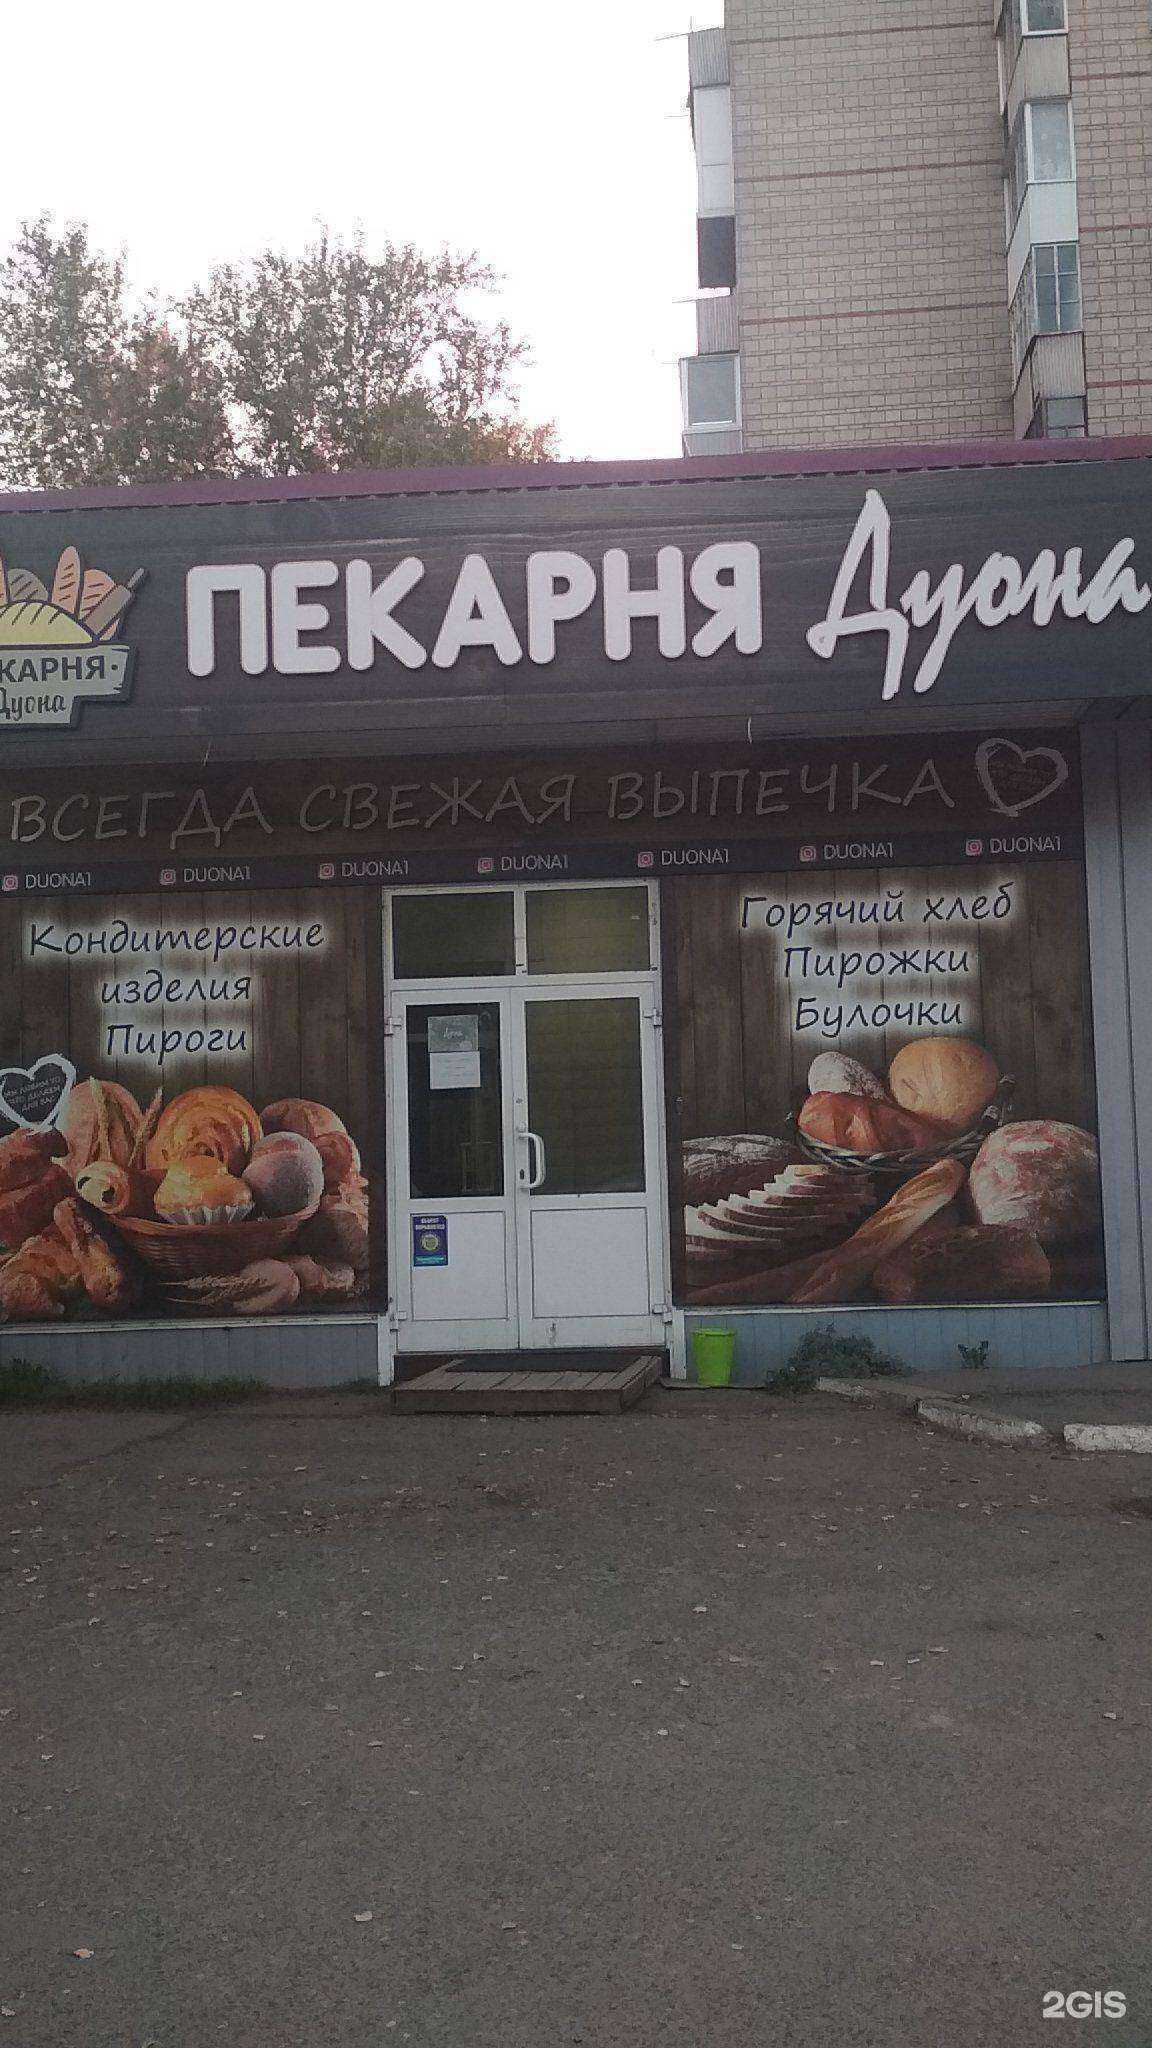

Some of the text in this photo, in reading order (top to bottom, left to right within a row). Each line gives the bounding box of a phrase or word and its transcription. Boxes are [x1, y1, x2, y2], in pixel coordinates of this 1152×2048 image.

[186, 488, 1152, 700] ПЕКАРНЯ Дуона
[11, 787, 274, 850] ВСЕГДА
[300, 775, 575, 832] СВЕЖАЯ
[607, 758, 955, 820] ВЫПЕЧКА
[25, 835, 1061, 889] DUONA1 DUONA1 DUONA1 DUONA1 DUONA1 DUONA1 DUONA1
[741, 881, 1014, 939] Горячий хлеб
[29, 919, 326, 962] Кондитерские
[101, 969, 251, 1004] изделия
[784, 946, 970, 989] Пирожки
[795, 997, 963, 1039] Булочки
[106, 1024, 247, 1066] Пироги
